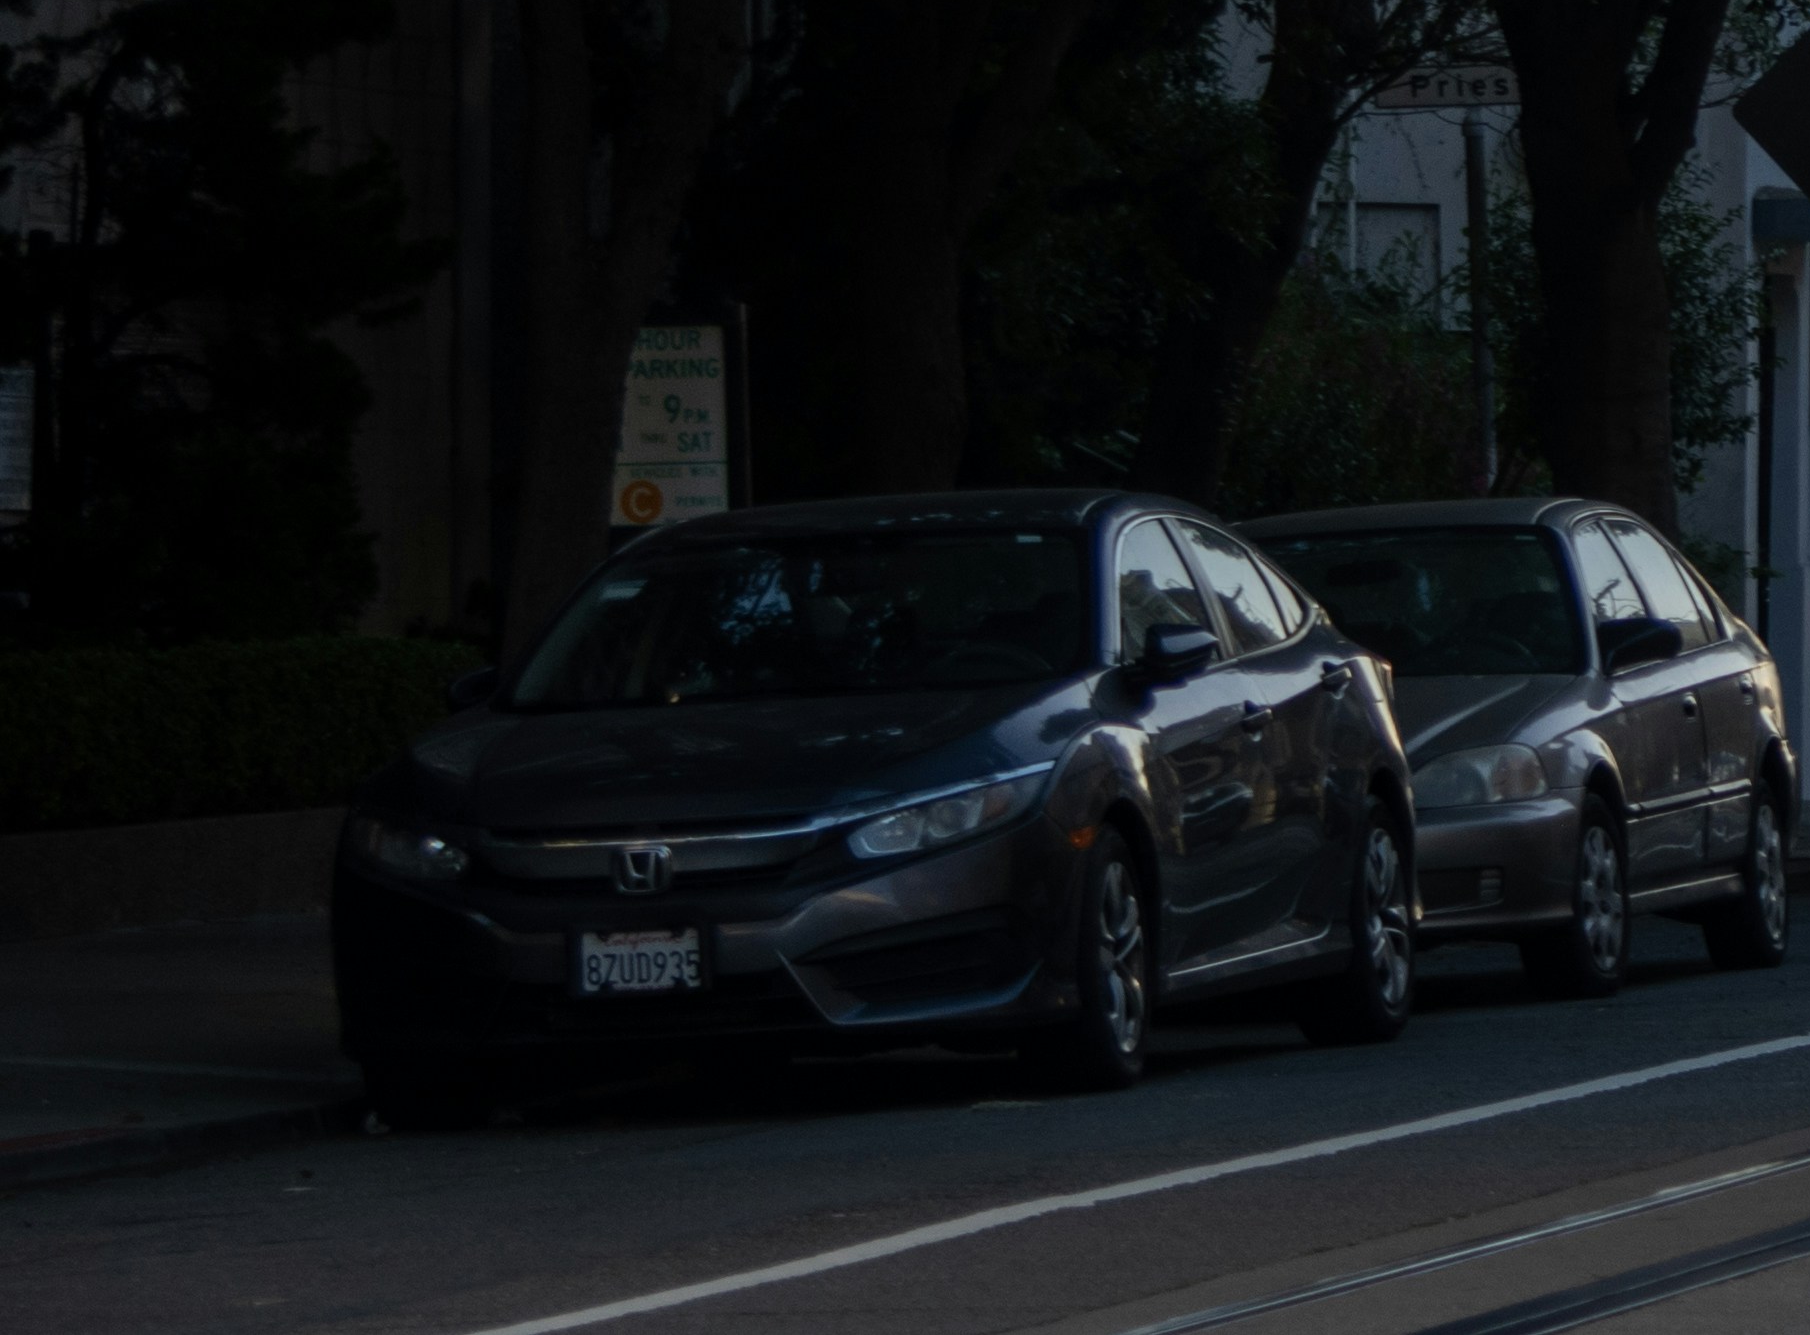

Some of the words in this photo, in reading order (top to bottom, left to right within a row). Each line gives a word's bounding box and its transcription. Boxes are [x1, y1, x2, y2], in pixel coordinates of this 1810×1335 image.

[1411, 74, 1509, 98] Pries
[664, 394, 681, 424] 9
[677, 431, 713, 453] SAT
[586, 949, 702, 986] 8ZUD935
